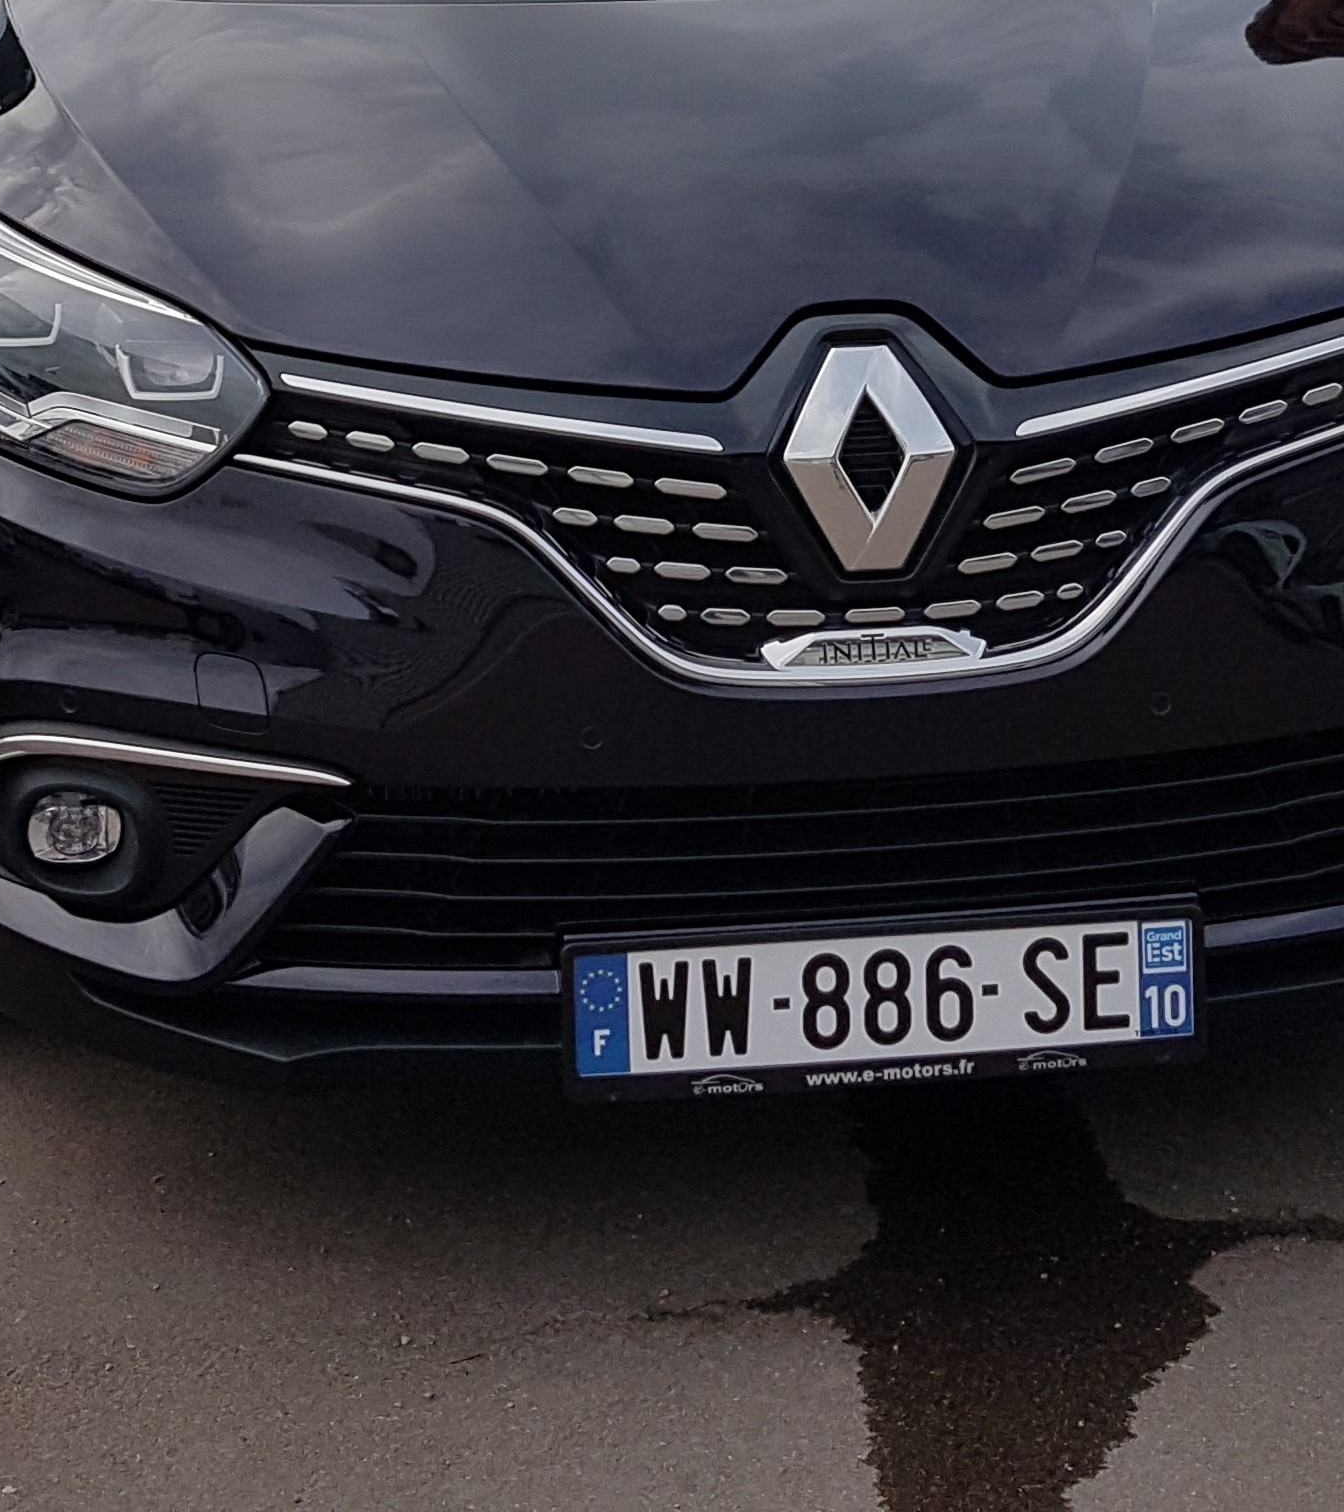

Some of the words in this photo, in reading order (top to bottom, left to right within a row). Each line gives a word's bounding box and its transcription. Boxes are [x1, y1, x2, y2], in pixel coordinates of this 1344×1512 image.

[1146, 930, 1182, 941] Grand
[1146, 942, 1183, 963] Est
[1144, 984, 1187, 1029] 10
[593, 1028, 611, 1057] F
[806, 1058, 975, 1087] www.e-motors.fr
